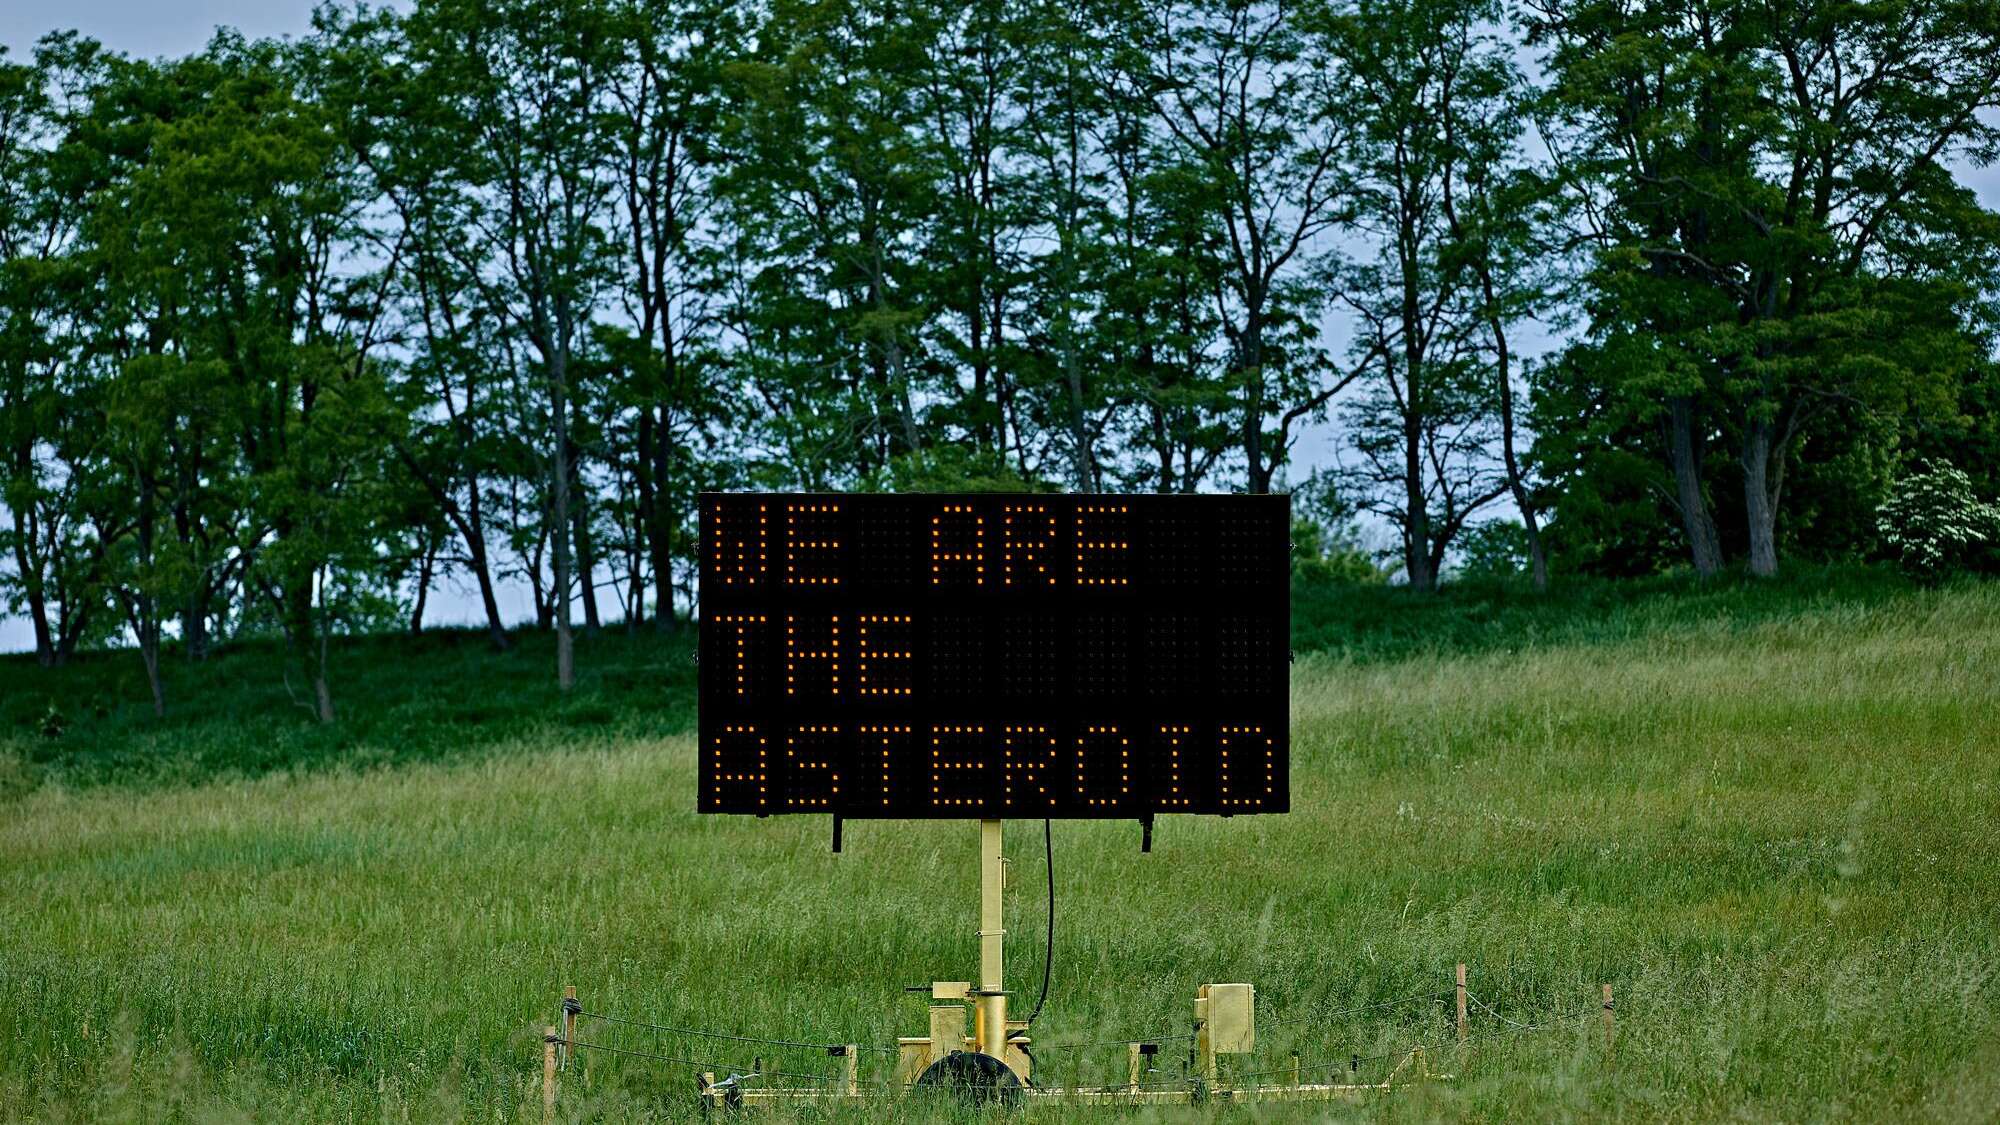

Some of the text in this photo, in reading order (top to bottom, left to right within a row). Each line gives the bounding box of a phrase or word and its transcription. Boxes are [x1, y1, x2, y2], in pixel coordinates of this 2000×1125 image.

[715, 505, 1127, 584] WE ARE
[715, 615, 910, 694] THE
[715, 726, 1272, 805] ASTEROID
